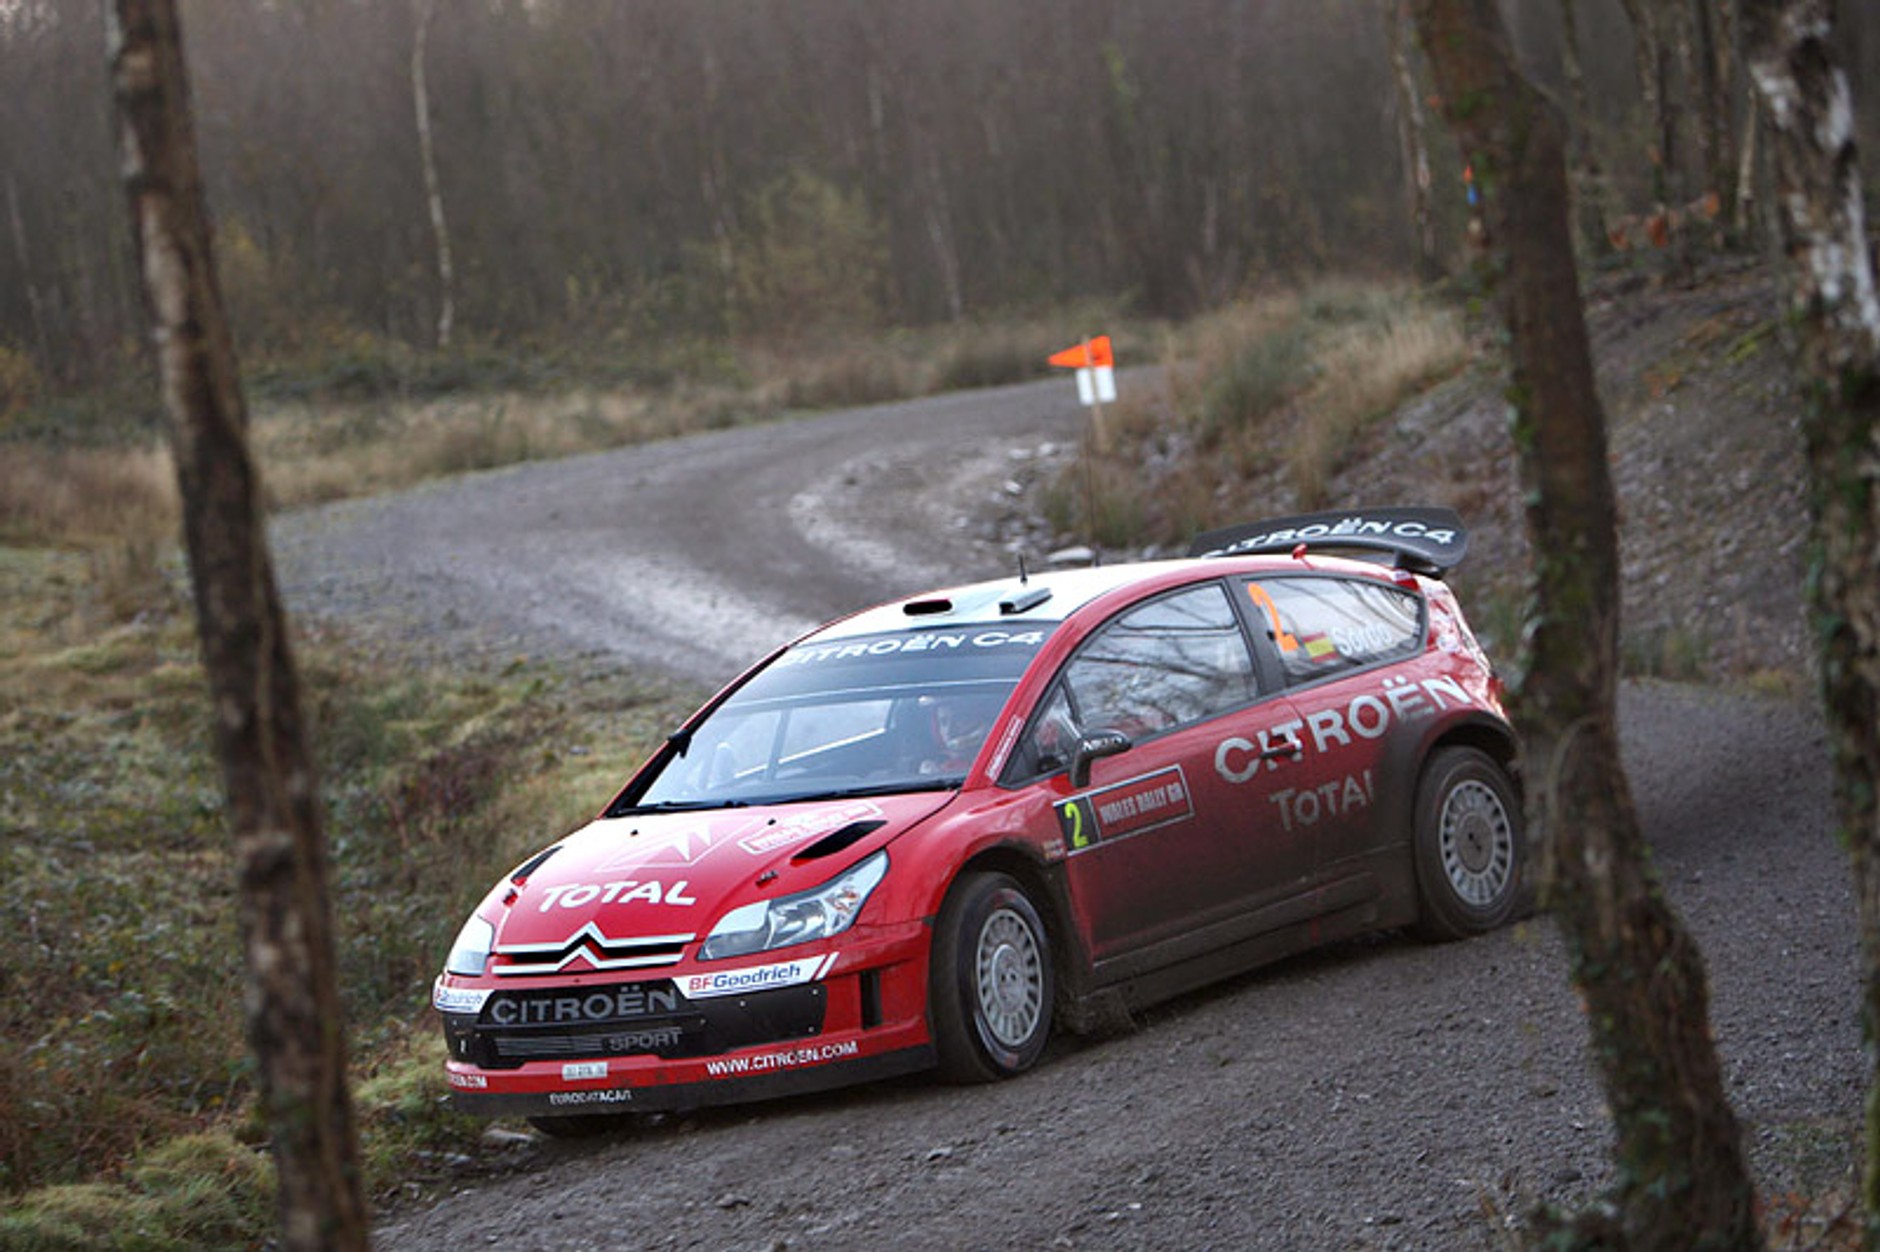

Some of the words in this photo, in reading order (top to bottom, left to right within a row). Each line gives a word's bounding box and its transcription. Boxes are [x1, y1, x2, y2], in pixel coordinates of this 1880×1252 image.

[1248, 582, 1299, 653] 2
[973, 631, 1046, 648] C4
[1214, 675, 1474, 784] CITROËN
[1064, 802, 1089, 848] 2
[537, 879, 697, 913] TOTAL
[688, 963, 801, 991] BFGoodrich
[490, 984, 678, 1025] CITROËN
[608, 1030, 684, 1052] SPORT
